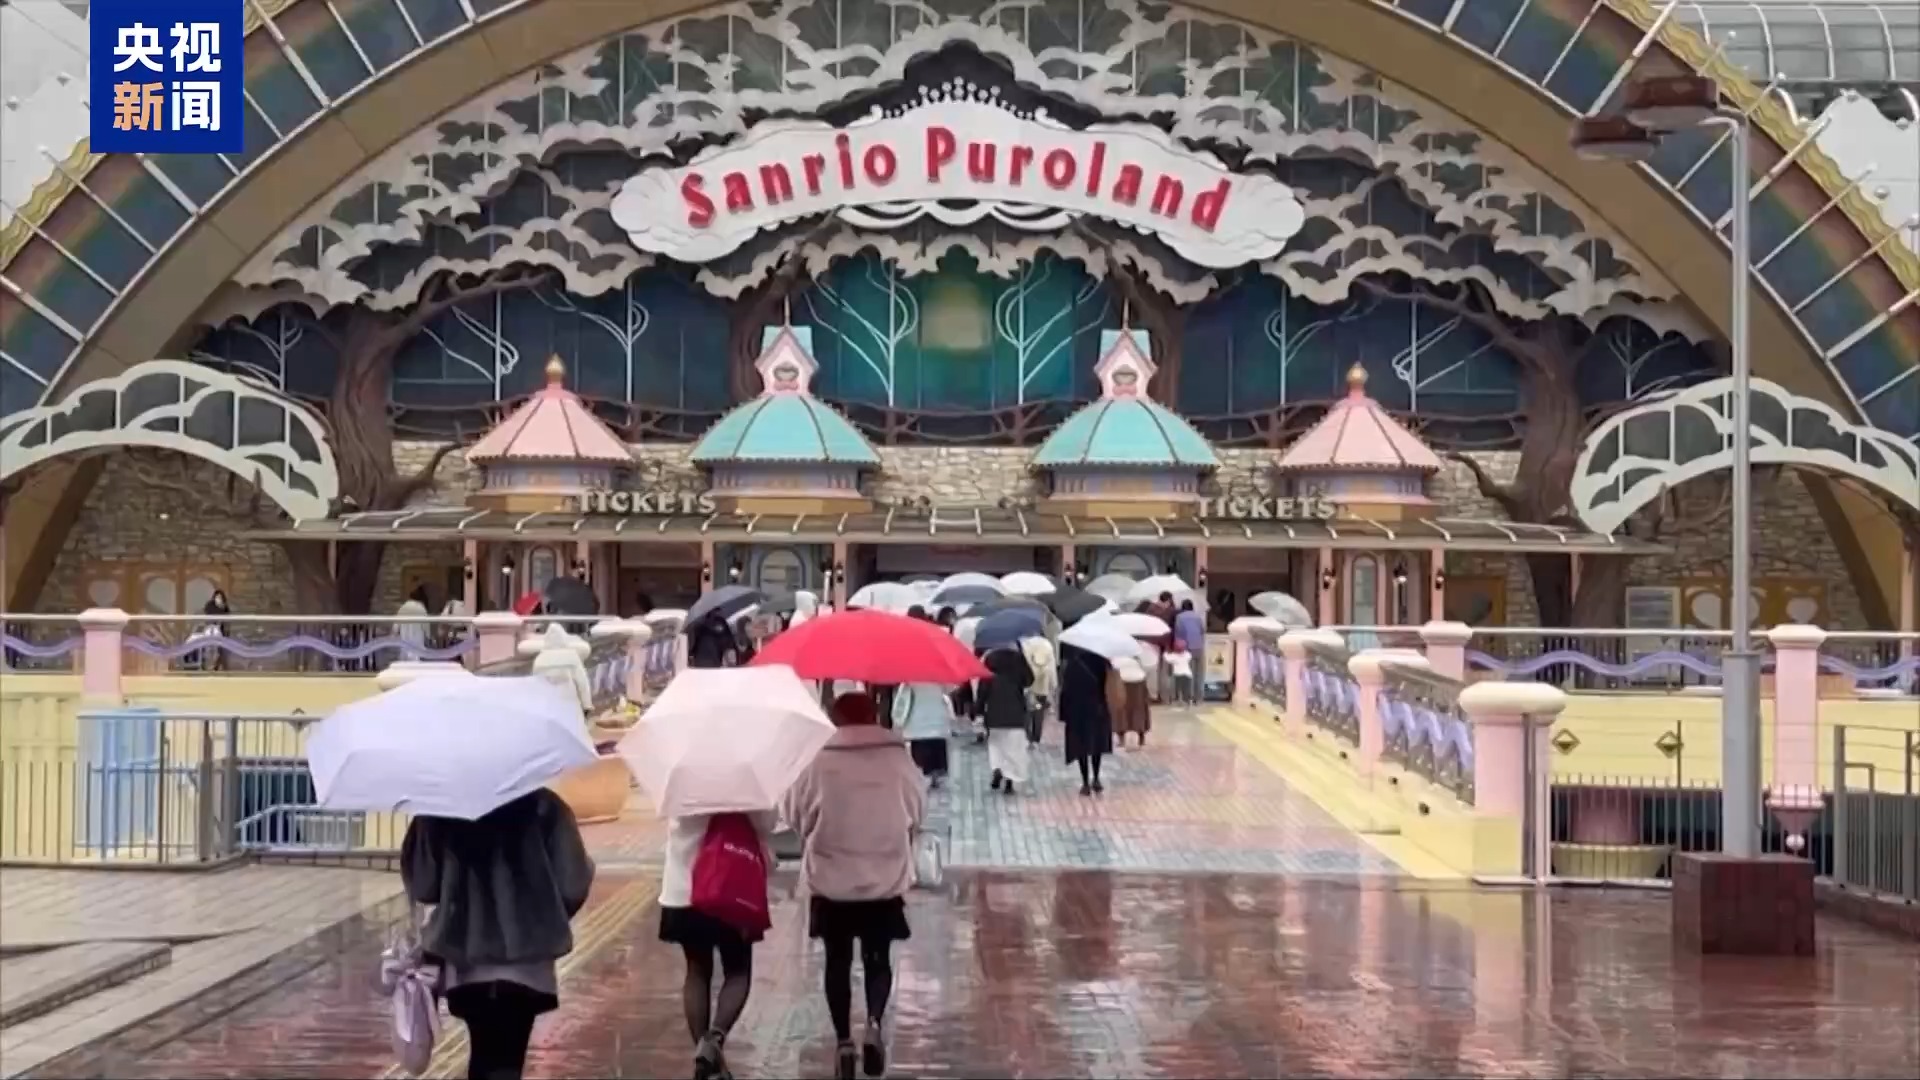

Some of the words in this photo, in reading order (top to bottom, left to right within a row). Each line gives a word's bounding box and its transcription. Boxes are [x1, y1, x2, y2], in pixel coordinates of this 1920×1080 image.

[681, 132, 897, 229] Sanrio
[926, 126, 1232, 232] Puroland
[579, 490, 716, 513] TICKETS
[1199, 497, 1336, 519] TICKETS
